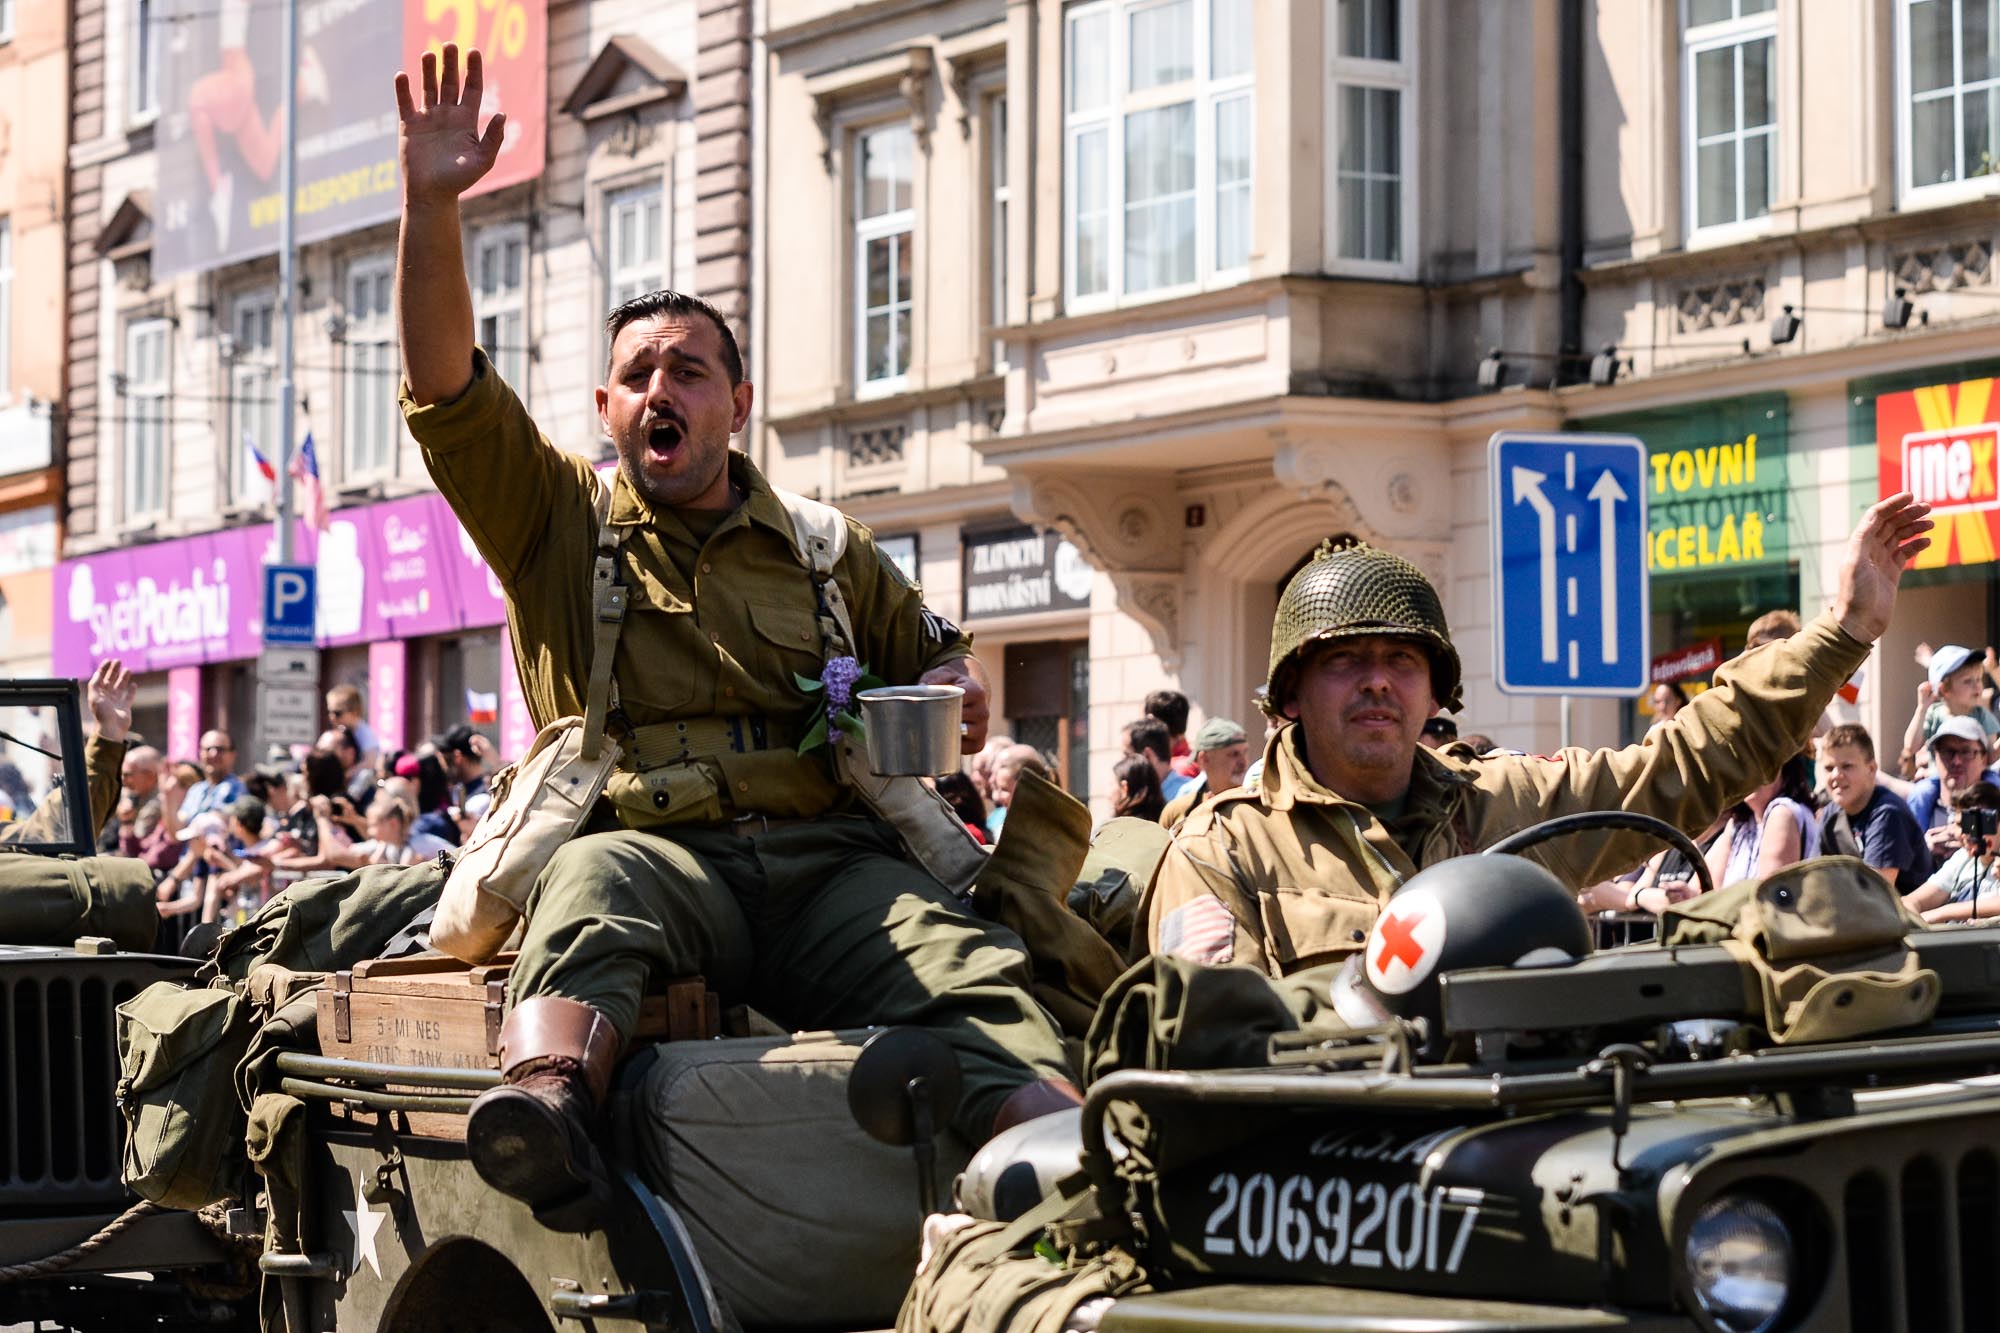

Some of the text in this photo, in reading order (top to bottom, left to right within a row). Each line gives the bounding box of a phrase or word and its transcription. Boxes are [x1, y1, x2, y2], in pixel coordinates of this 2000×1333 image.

[1650, 433, 1758, 494] TOVNÍ
[273, 572, 308, 621] P
[1203, 1171, 1486, 1275] 20692017
